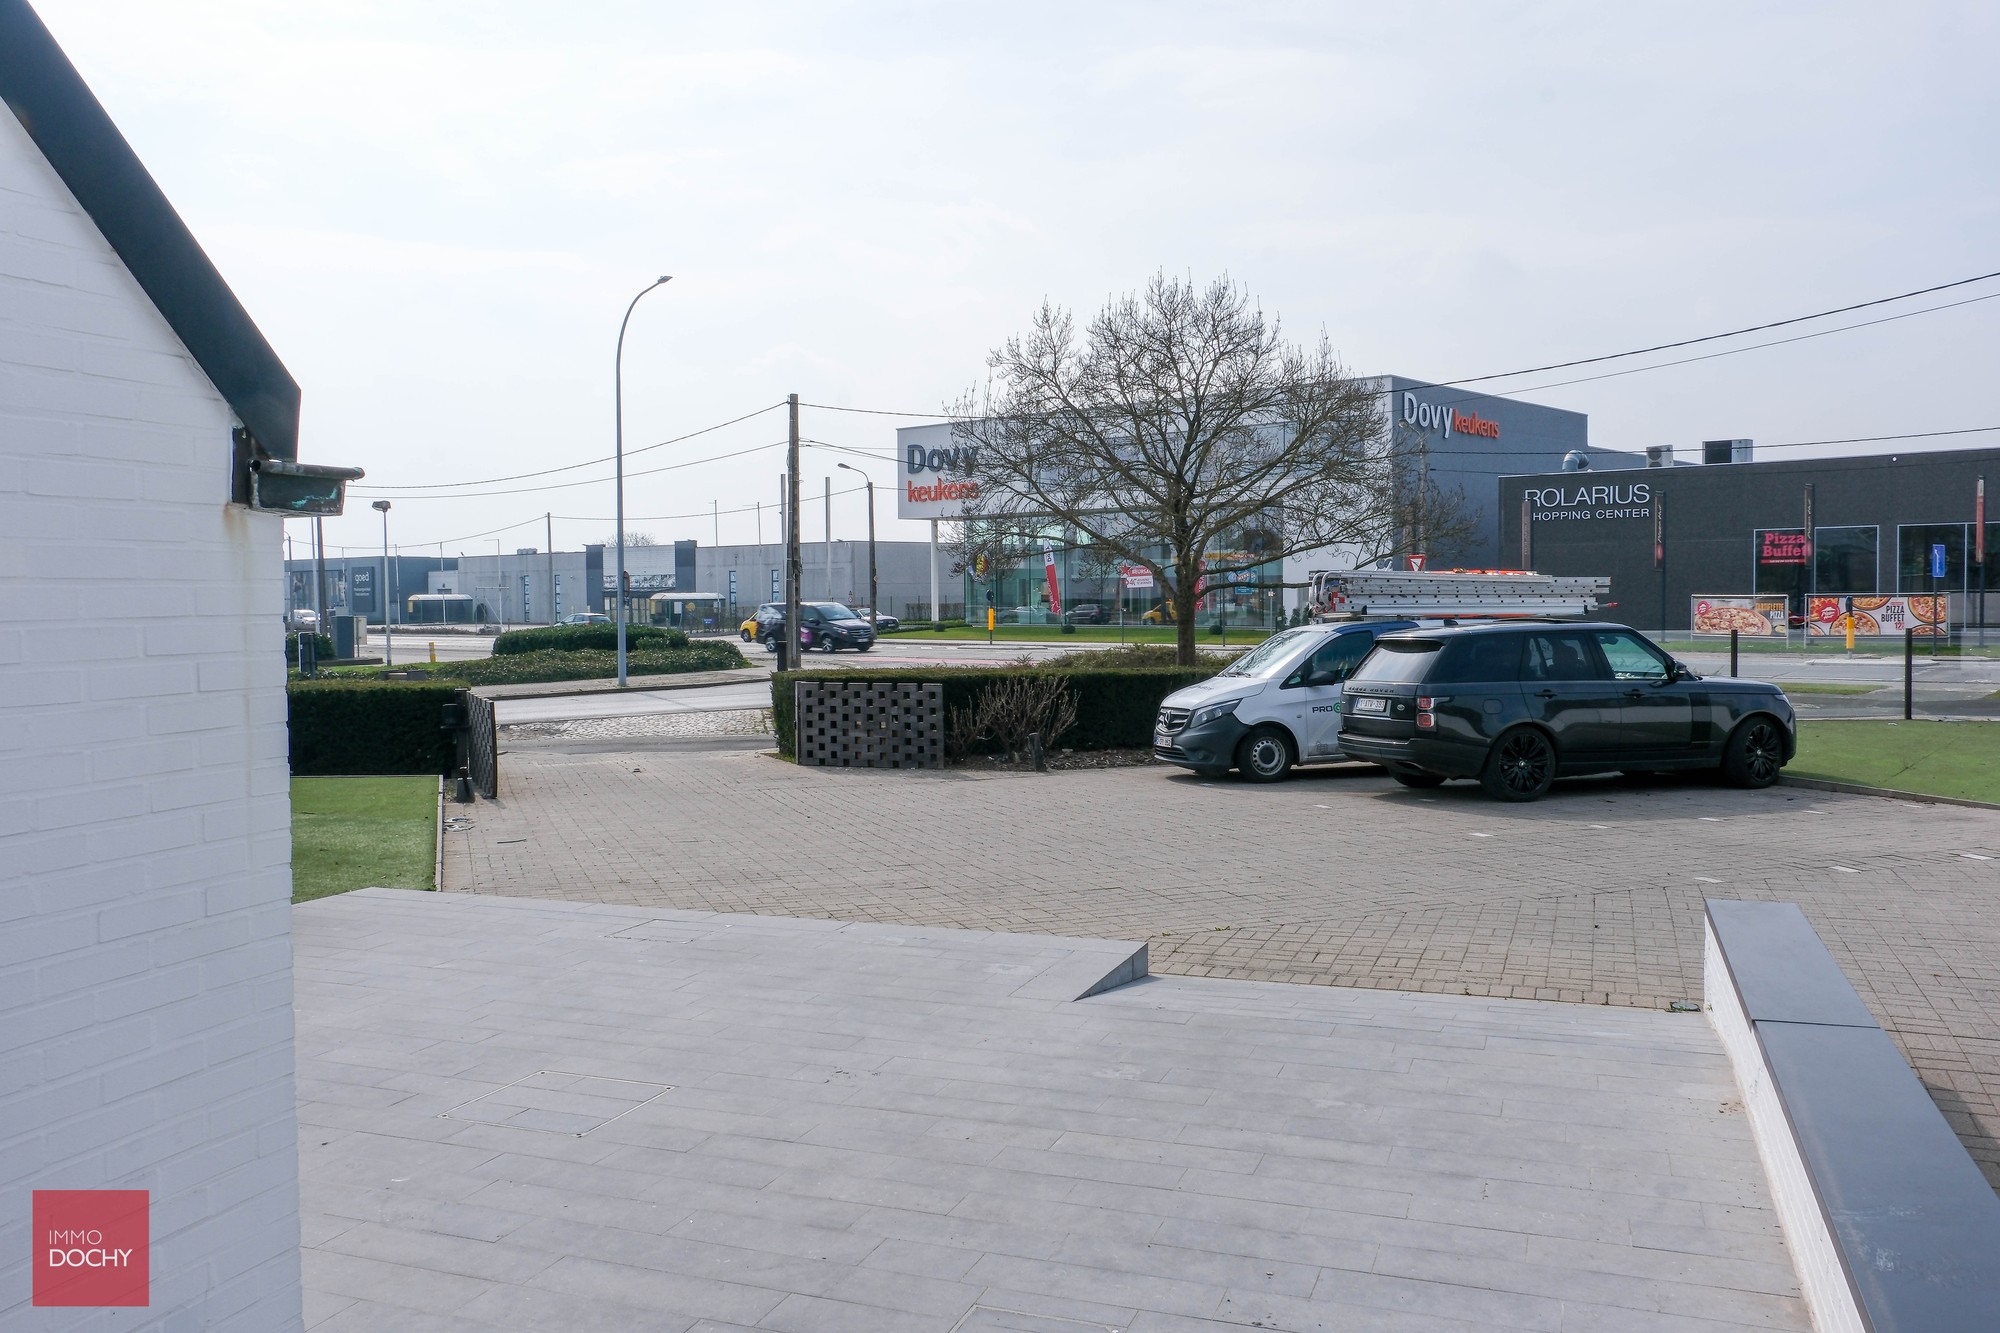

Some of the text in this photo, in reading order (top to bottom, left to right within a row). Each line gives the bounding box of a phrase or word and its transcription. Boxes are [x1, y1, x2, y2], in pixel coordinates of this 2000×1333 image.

[1403, 391, 1500, 439] Dovy keukens
[907, 444, 979, 477] Dovy
[907, 478, 979, 502] keukens
[1524, 484, 1650, 507] ROLARIUS
[1533, 508, 1650, 521] HOPPING CENTER
[1764, 532, 1806, 544] Pizza
[354, 571, 370, 584] goed
[1769, 610, 1785, 619] PIZZA
[1885, 605, 1904, 613] PIZZA
[1880, 613, 1904, 622] BUFFET
